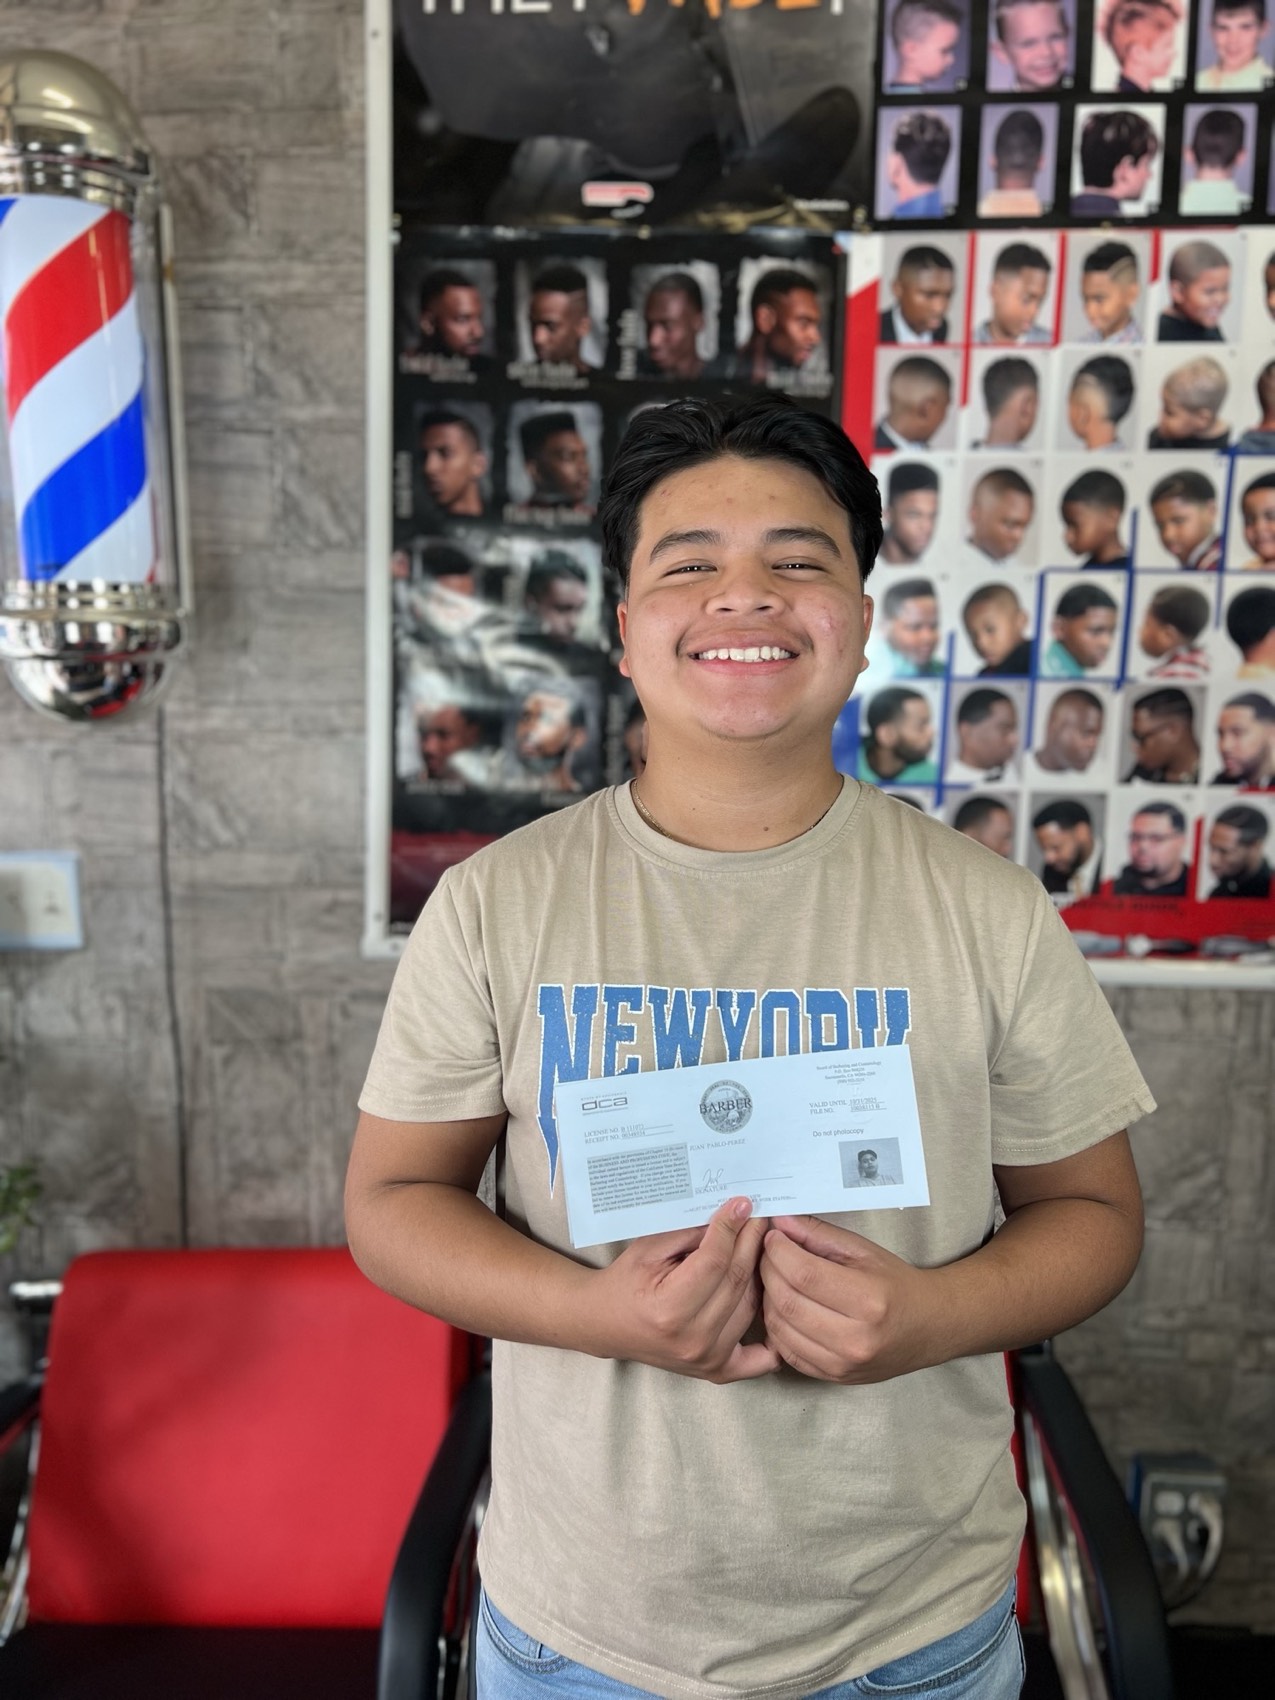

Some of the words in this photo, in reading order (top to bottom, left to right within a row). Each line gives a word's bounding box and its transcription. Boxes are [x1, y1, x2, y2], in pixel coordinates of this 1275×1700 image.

[582, 1097, 628, 1111] dca
[699, 1097, 753, 1115] BARBER
[584, 1130, 608, 1138] LICENSE
[833, 1128, 865, 1136] photocopy
[585, 1135, 608, 1144] RECEIPT
[690, 1144, 705, 1152] JUAN
[706, 1139, 746, 1149] PABLO-PEREZ
